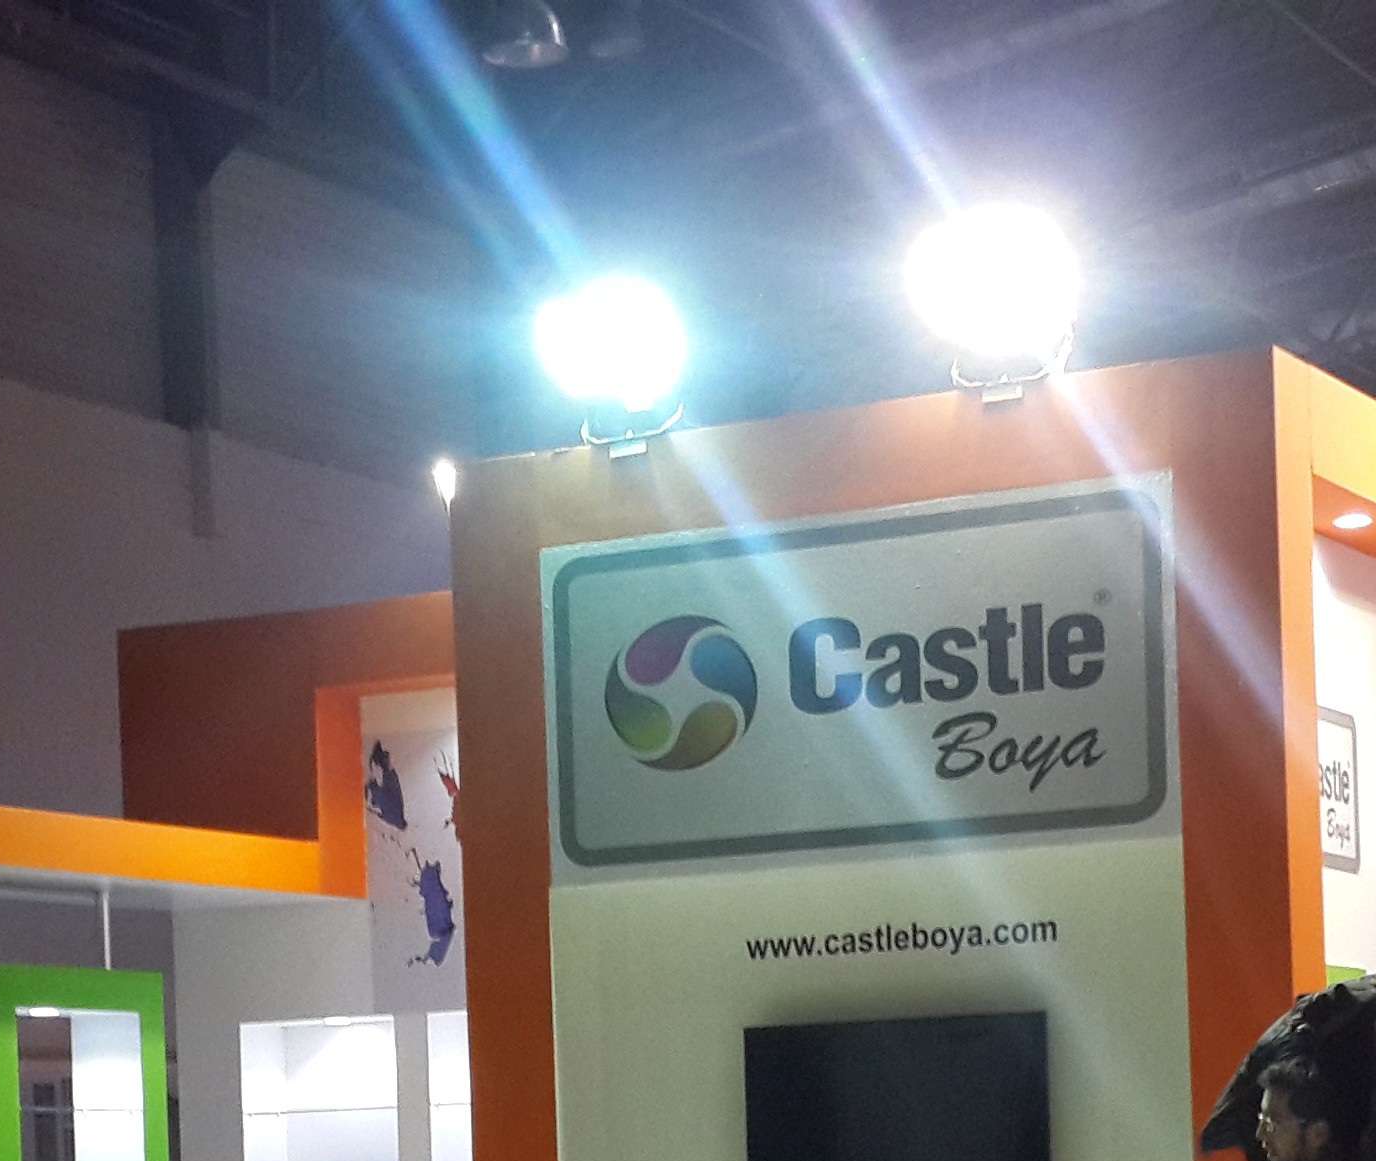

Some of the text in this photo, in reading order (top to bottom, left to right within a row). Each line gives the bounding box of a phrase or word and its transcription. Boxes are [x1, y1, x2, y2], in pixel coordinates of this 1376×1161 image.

[788, 603, 1106, 716] Castle
[931, 711, 1108, 793] Boya
[1319, 760, 1350, 805] astle
[745, 919, 1060, 961] www.castleboya.com
